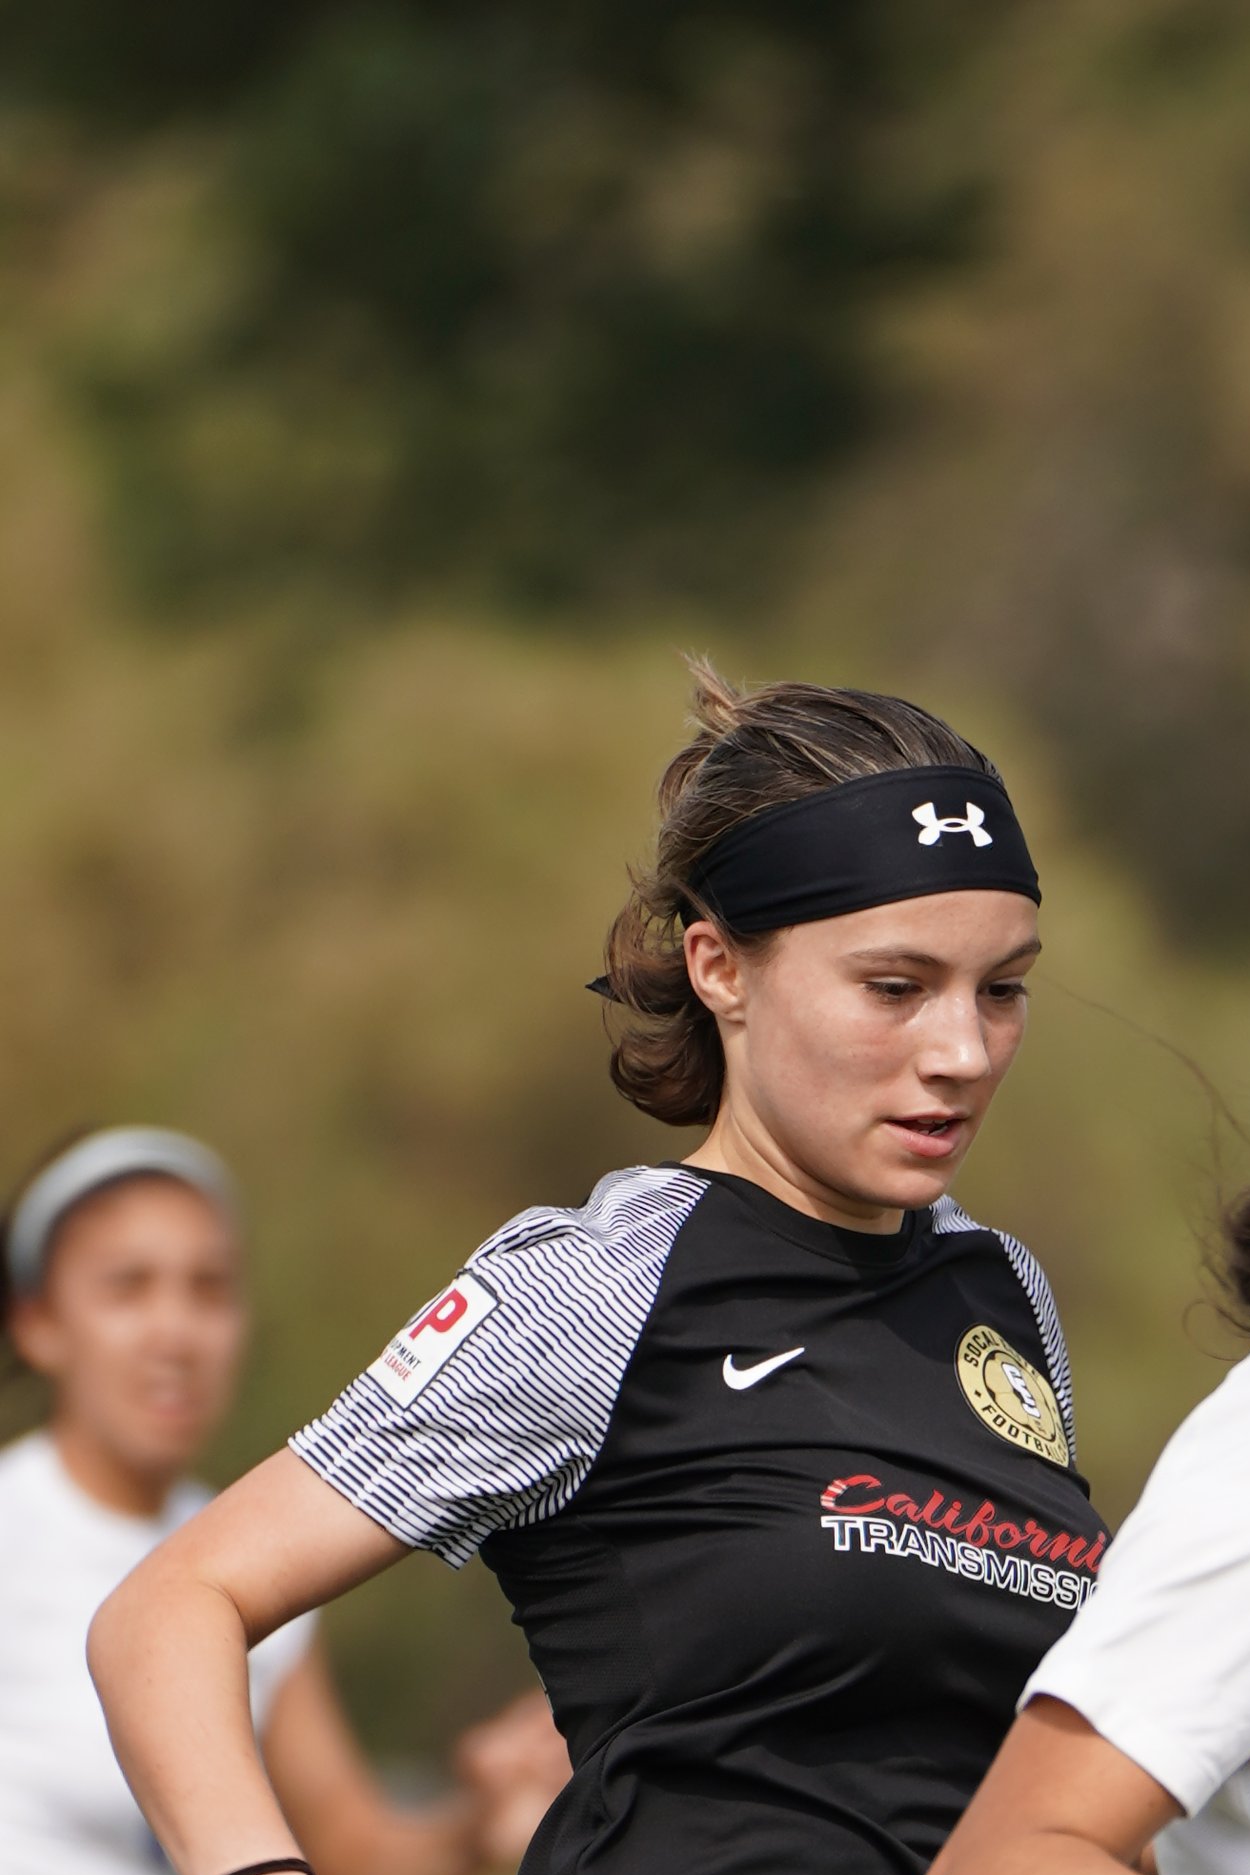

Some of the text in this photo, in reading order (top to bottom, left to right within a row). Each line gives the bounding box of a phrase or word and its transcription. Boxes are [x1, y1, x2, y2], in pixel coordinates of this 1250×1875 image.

[384, 1353, 411, 1381] LEAGUE
[963, 1330, 1000, 1368] SOCAL
[820, 1515, 1099, 1611] TRANSMISSI
